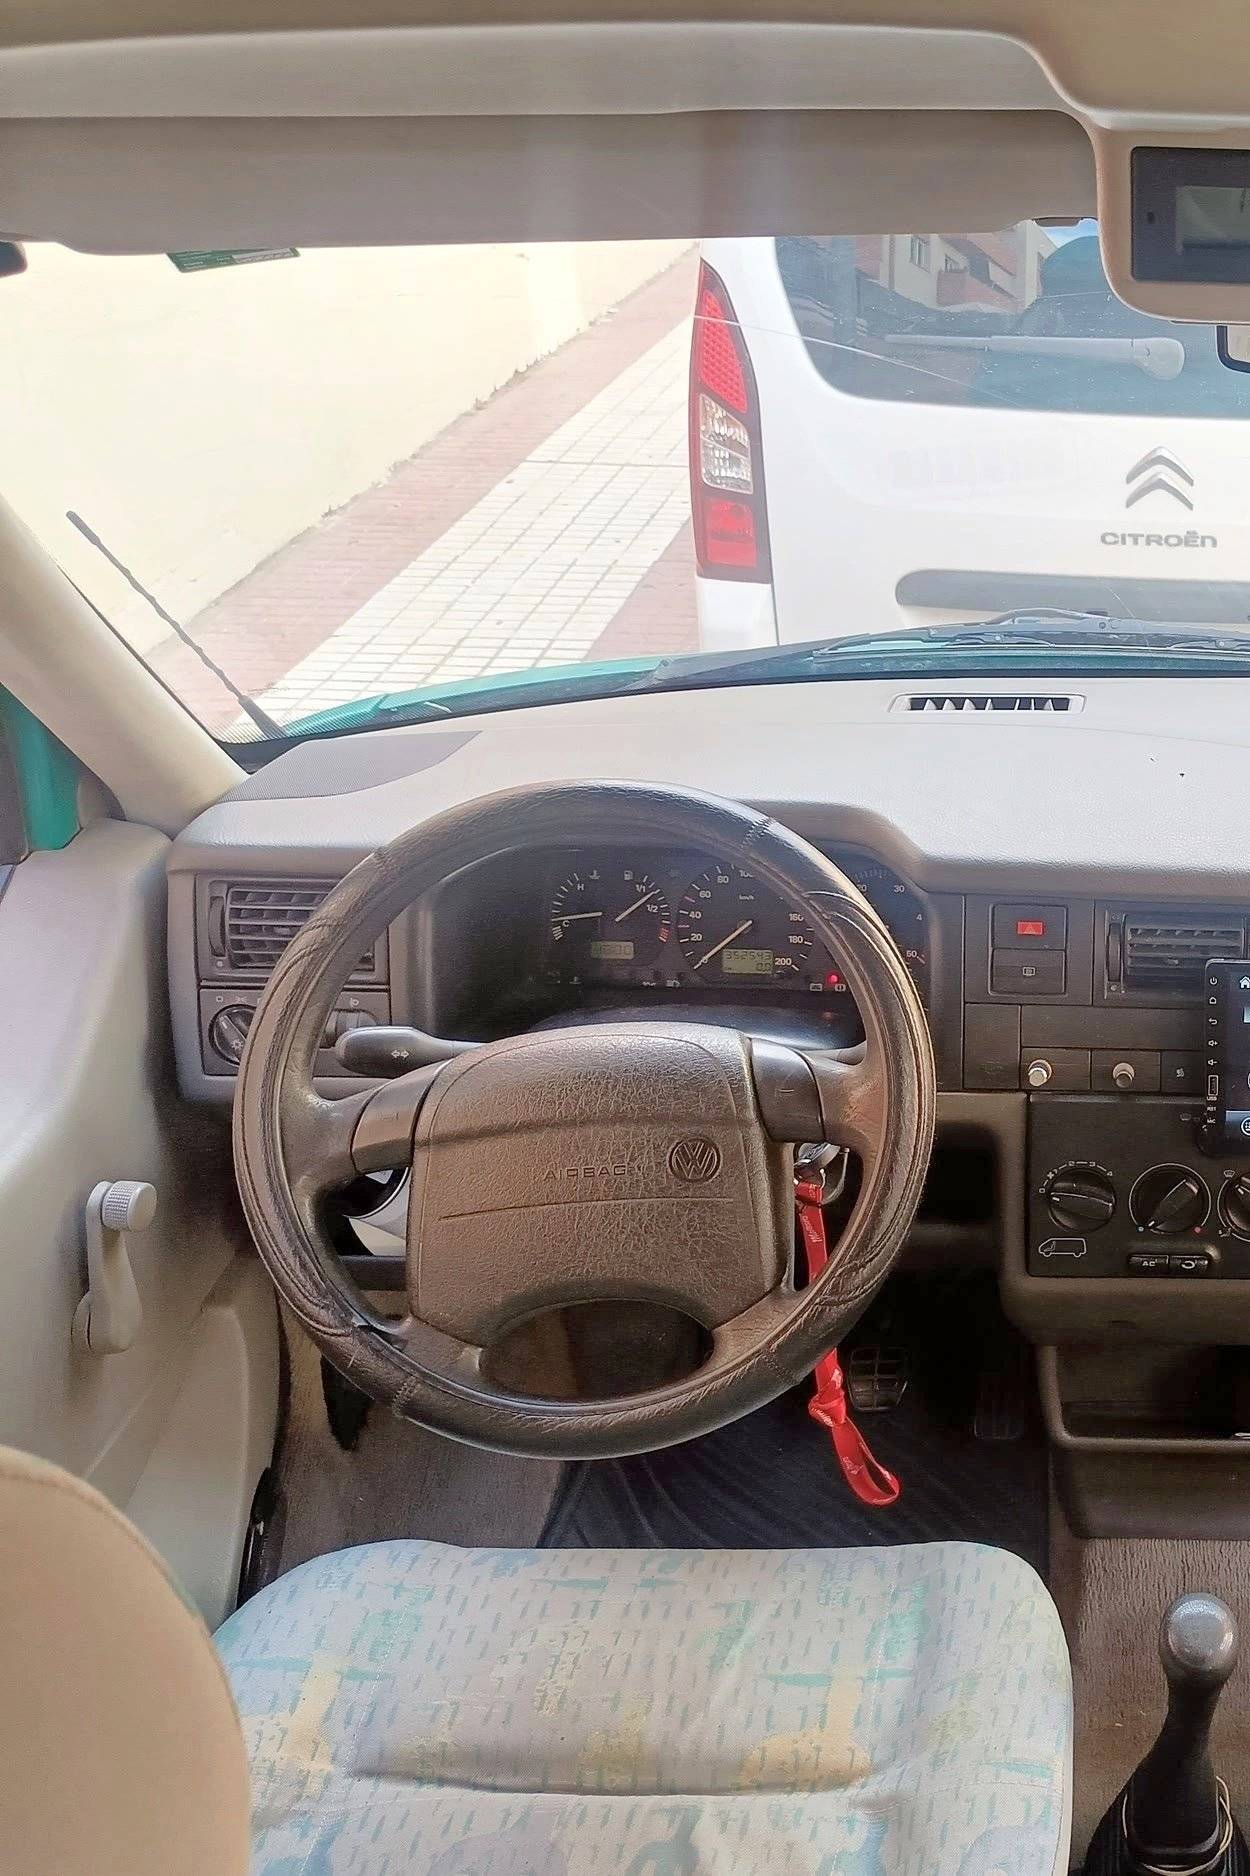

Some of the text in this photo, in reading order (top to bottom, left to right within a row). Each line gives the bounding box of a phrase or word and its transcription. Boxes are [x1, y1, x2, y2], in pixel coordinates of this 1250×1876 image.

[893, 884, 905, 893] 30
[699, 890, 711, 898] 60
[688, 911, 702, 919] 40
[690, 933, 702, 942] 20
[774, 957, 792, 967] 200
[543, 1163, 628, 1182] AIRBAG
